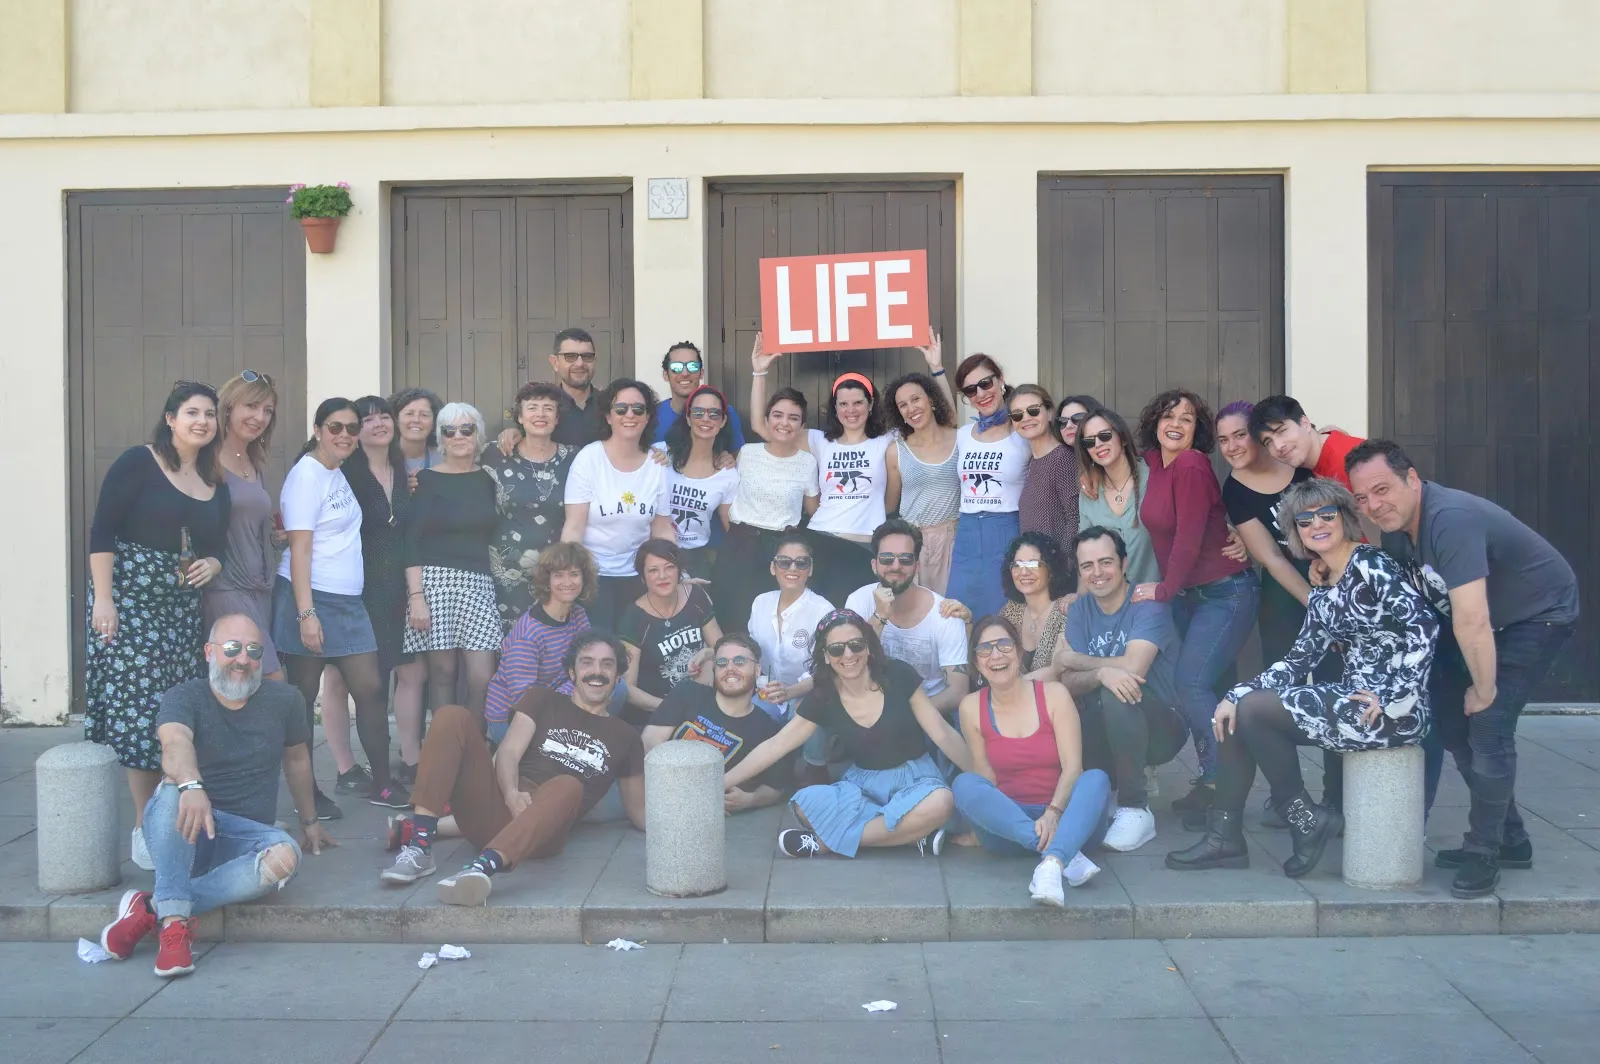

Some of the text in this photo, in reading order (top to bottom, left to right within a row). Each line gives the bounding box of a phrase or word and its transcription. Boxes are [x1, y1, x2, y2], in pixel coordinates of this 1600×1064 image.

[651, 184, 685, 196] CASA
[661, 198, 685, 214] 37
[776, 259, 912, 345] LIFE
[832, 451, 866, 461] LINDY
[964, 452, 1003, 460] BALBOA
[828, 460, 870, 469] LOVERS
[963, 461, 1000, 470] LOVERS
[672, 484, 707, 499] LINDY
